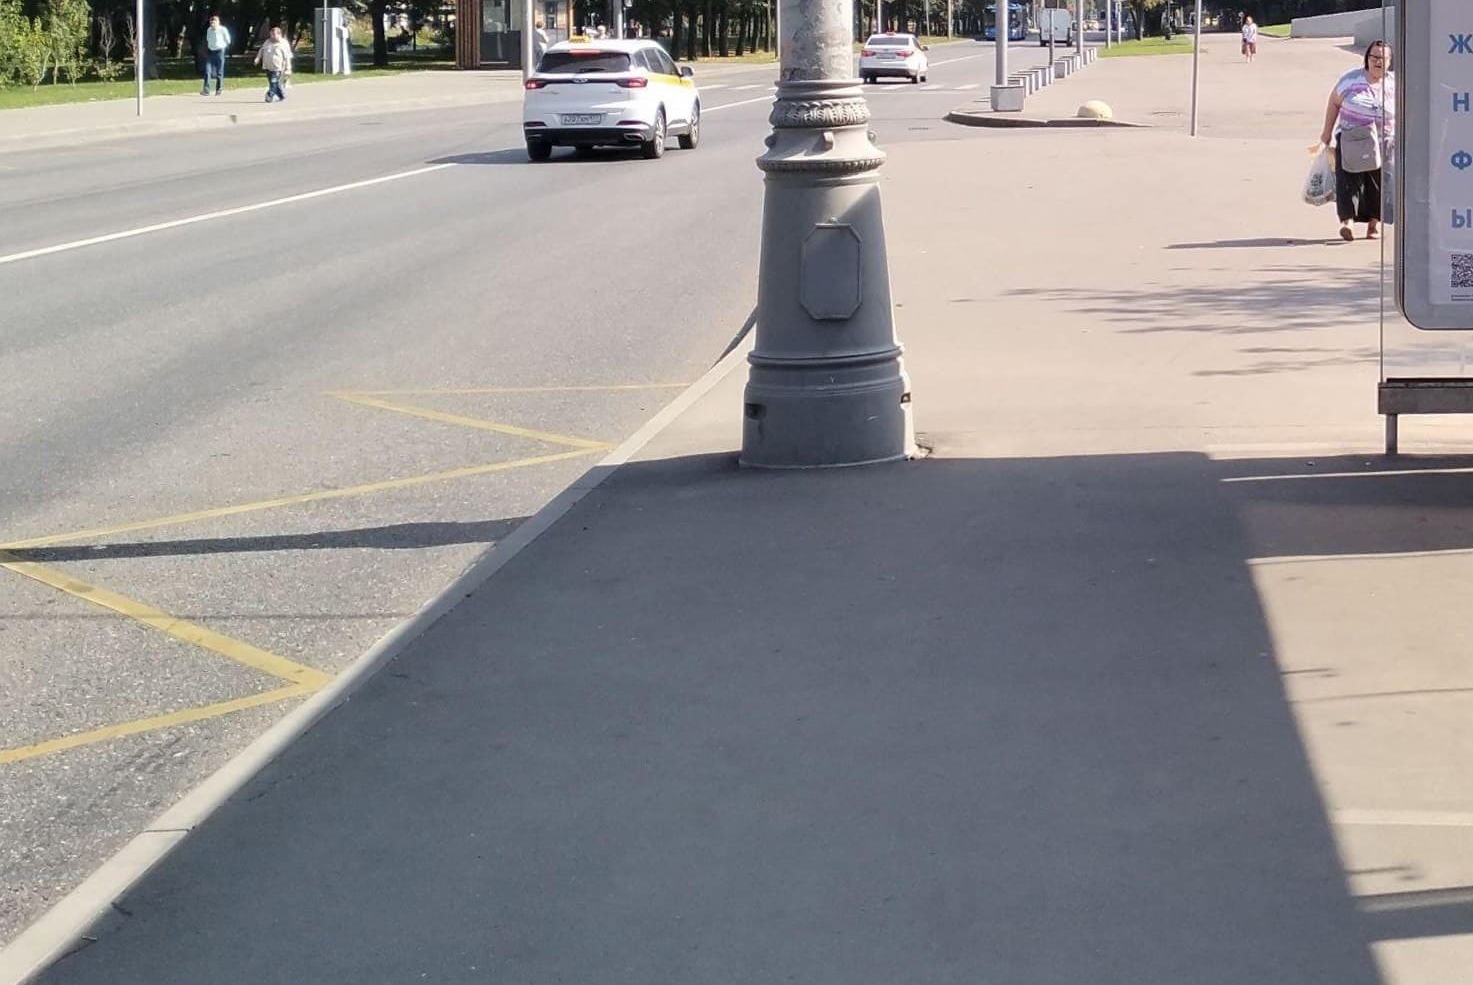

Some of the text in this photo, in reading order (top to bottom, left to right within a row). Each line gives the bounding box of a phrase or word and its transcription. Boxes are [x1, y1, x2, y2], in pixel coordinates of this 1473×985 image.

[1448, 34, 1473, 54] Ж
[1453, 92, 1469, 112] Н
[1451, 150, 1472, 170] Ф
[1451, 209, 1472, 228] Ы
